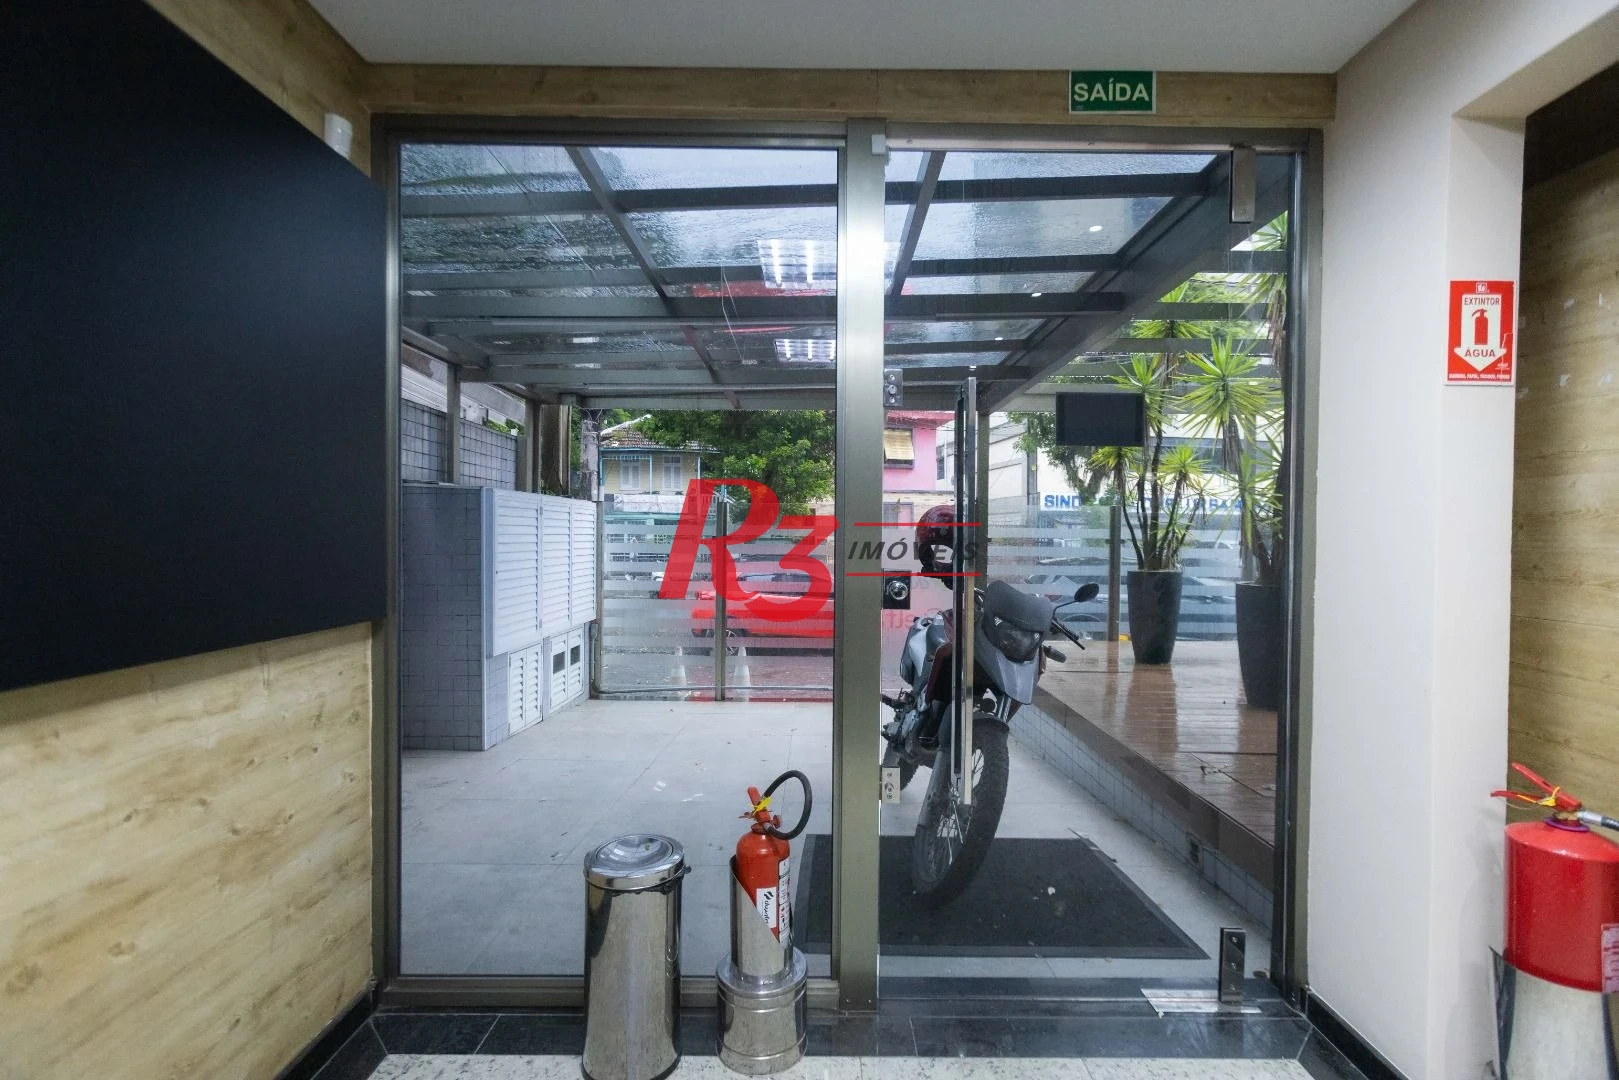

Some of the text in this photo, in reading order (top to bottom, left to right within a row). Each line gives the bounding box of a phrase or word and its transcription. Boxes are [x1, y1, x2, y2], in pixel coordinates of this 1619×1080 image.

[1073, 78, 1150, 102] SAÍDA
[1464, 297, 1500, 306] EXTINTOR
[1464, 347, 1496, 358] ÁGUA
